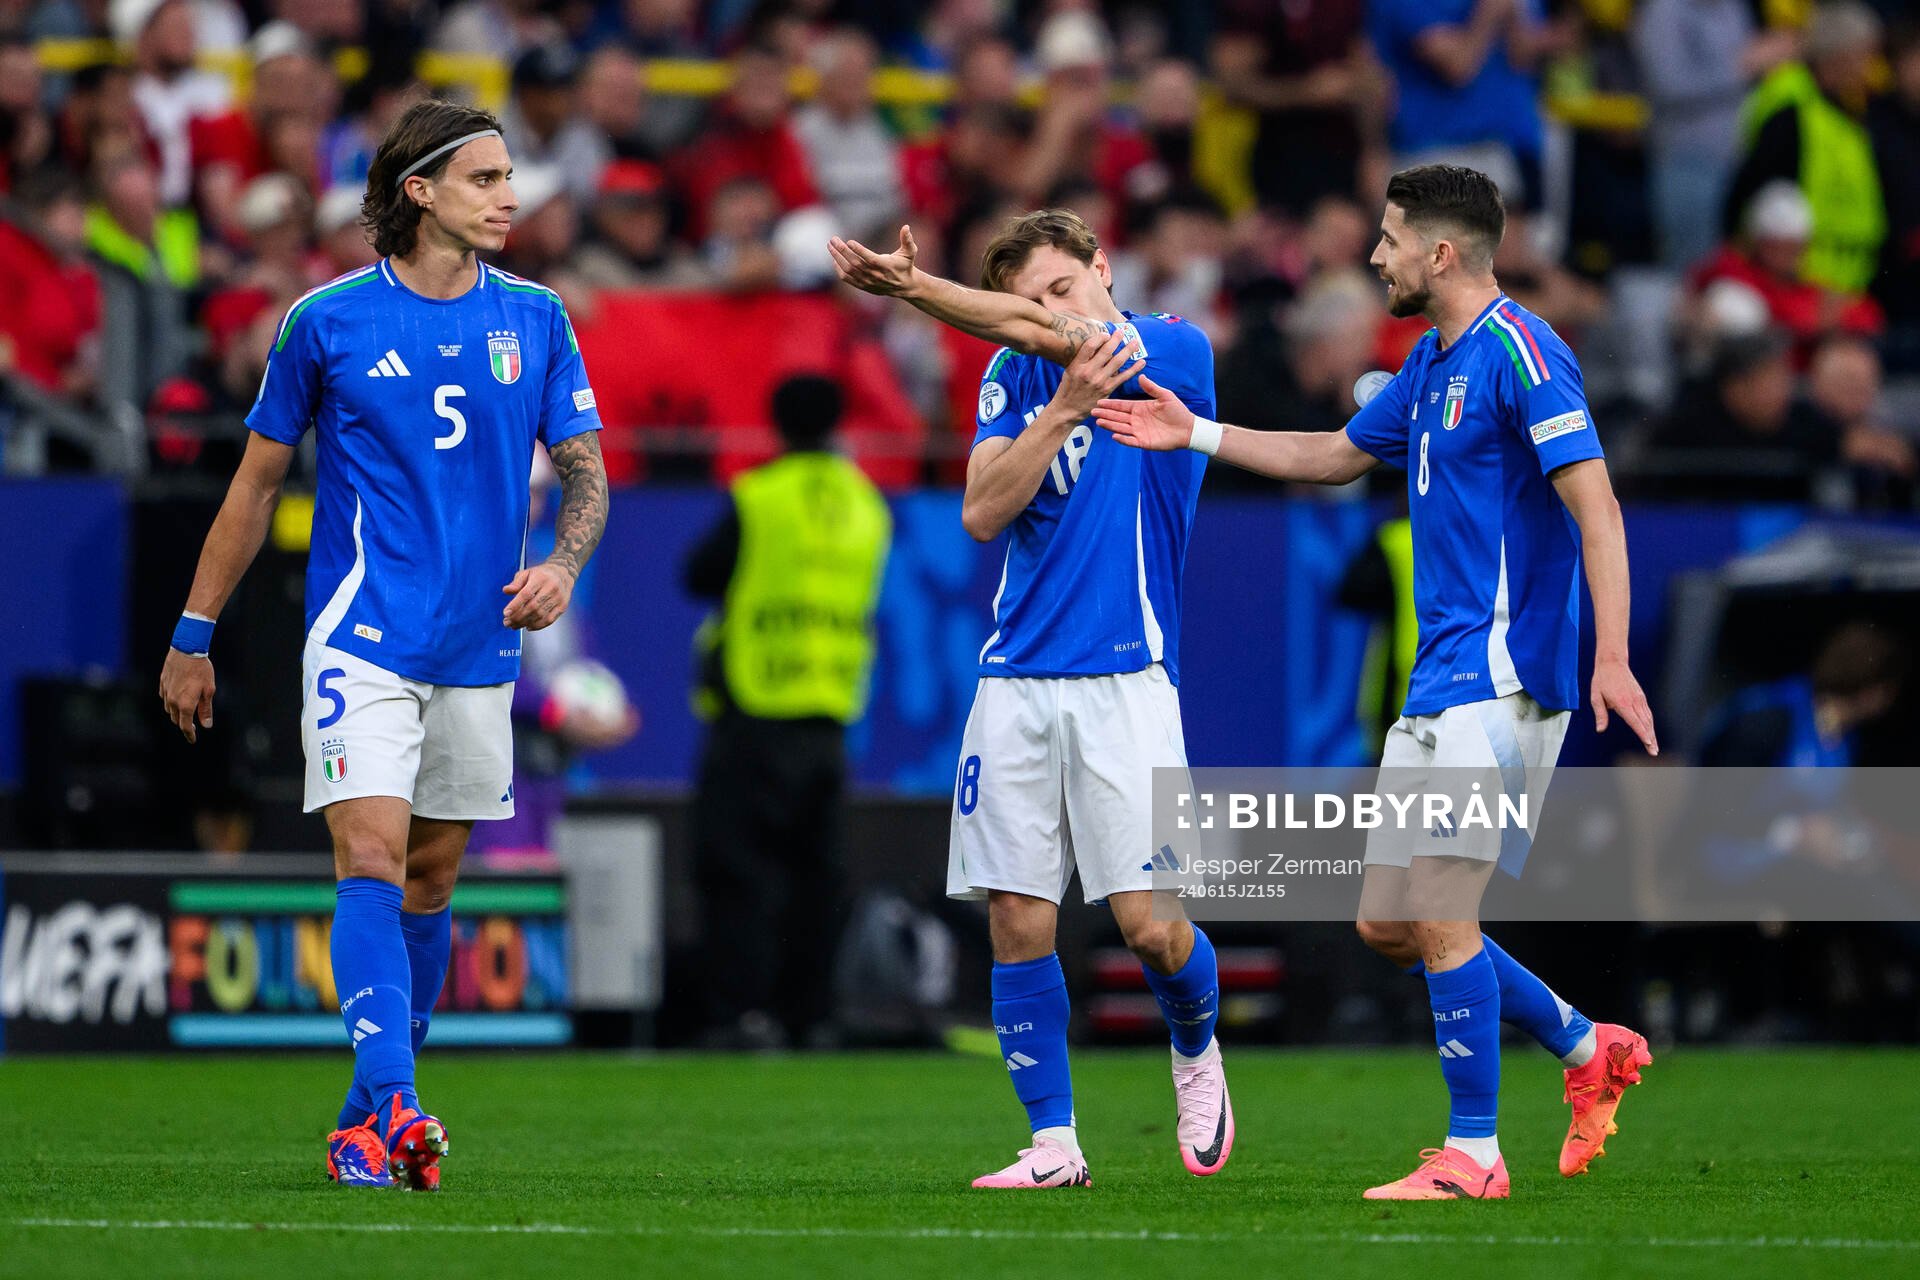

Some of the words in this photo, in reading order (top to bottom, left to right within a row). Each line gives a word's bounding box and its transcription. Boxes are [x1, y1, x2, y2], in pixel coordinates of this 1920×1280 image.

[491, 341, 517, 351] ITALIA
[434, 384, 467, 450] 5
[1532, 415, 1585, 440] FOUNDATION
[1417, 431, 1430, 496] 8
[317, 667, 346, 729] 5
[323, 747, 343, 758] ITALIA
